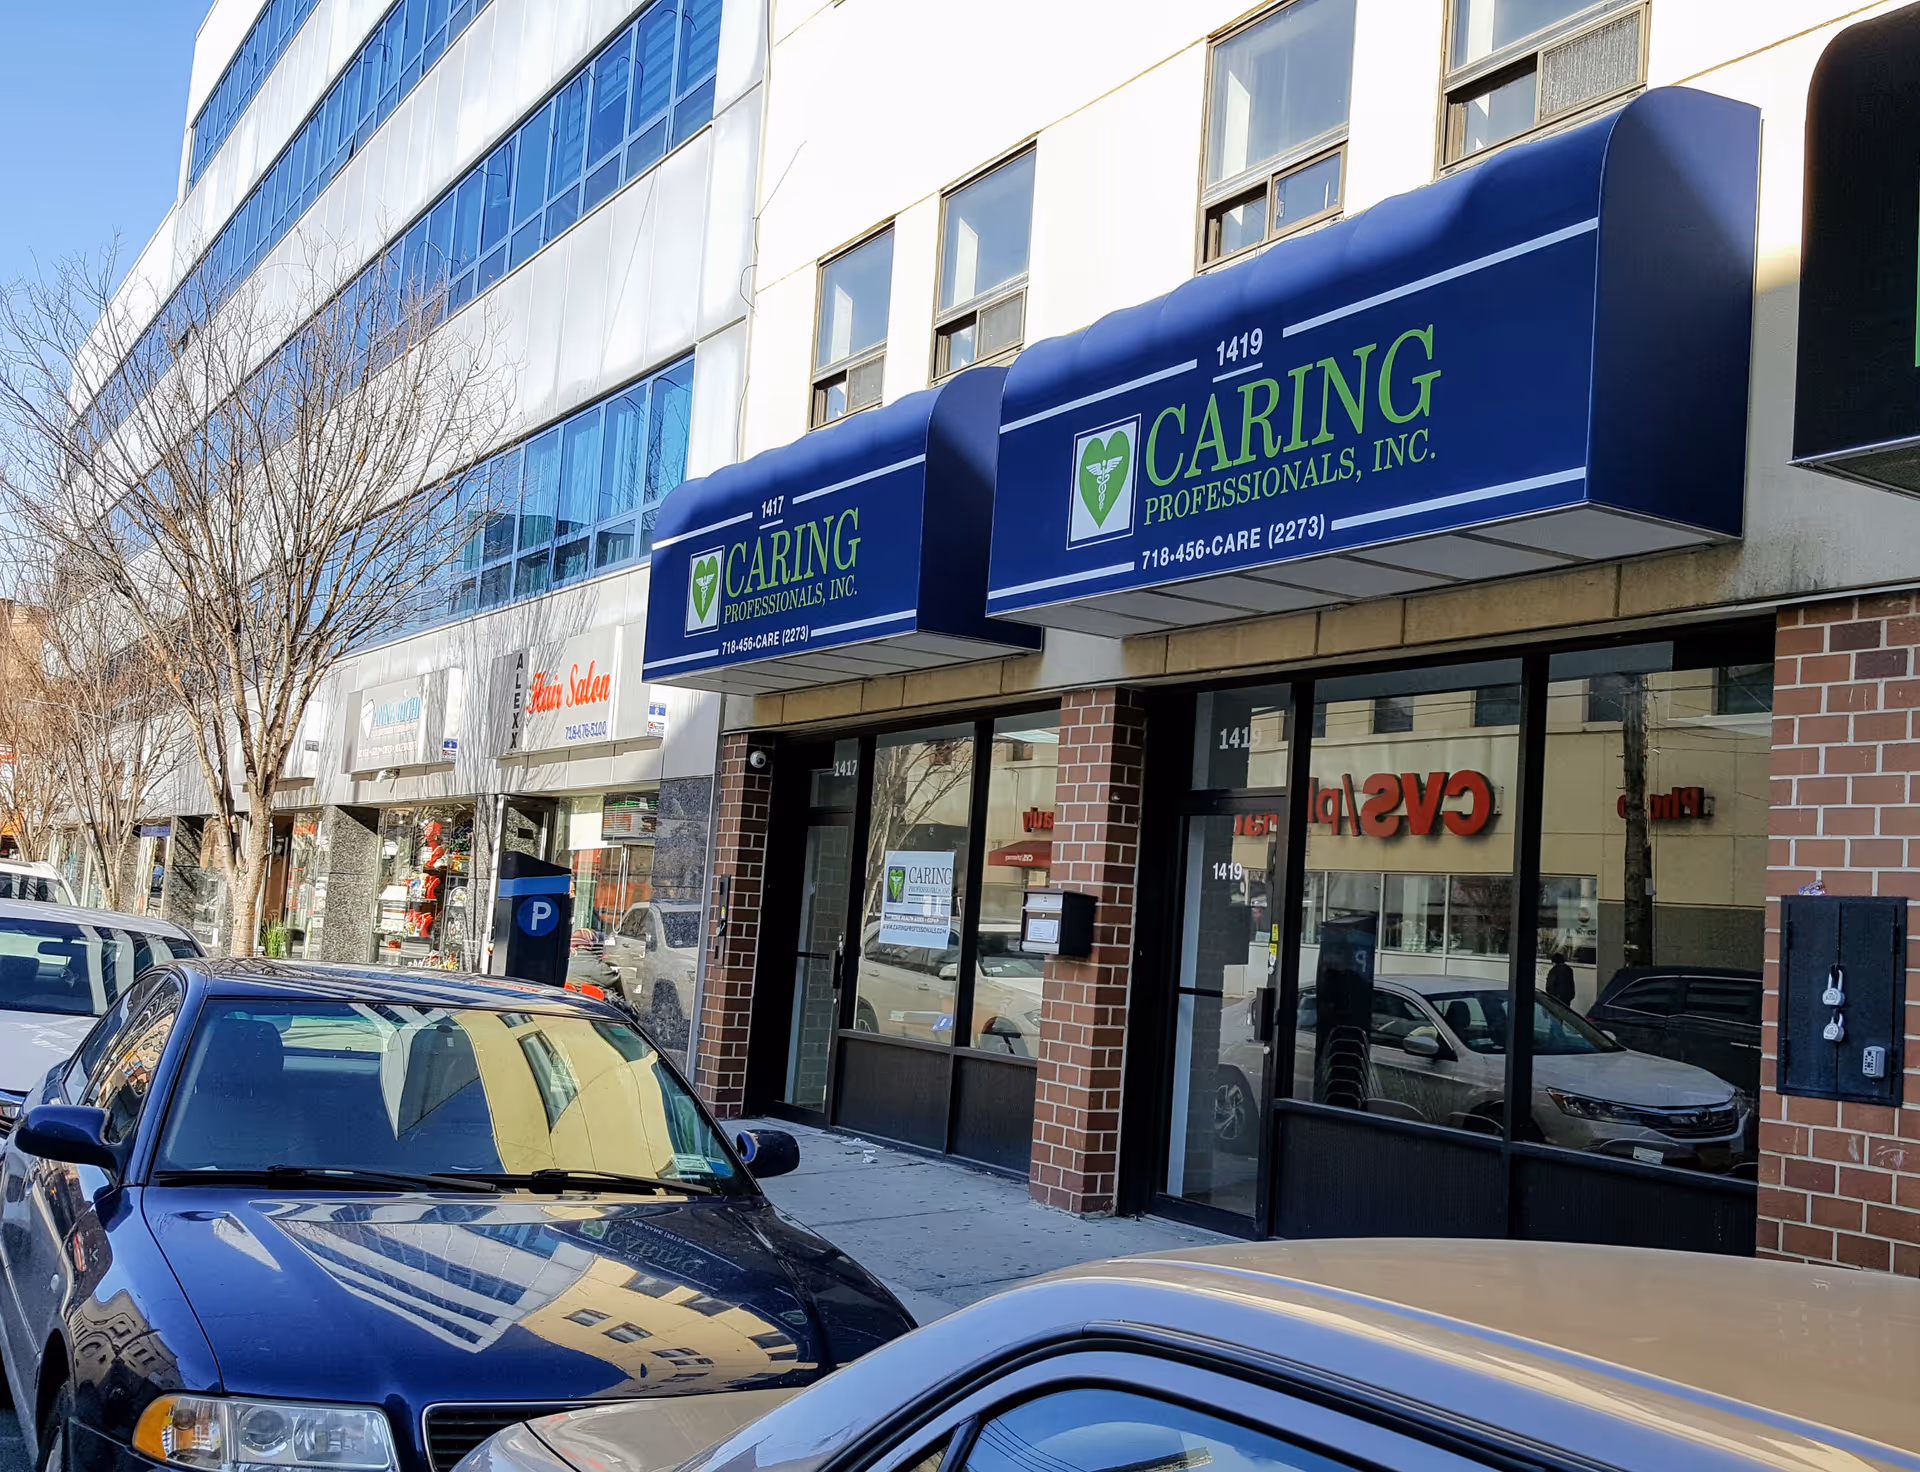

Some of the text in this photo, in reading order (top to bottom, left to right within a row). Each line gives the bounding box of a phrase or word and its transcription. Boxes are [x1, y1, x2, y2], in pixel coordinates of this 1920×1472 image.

[1216, 327, 1263, 366] 1419
[1145, 323, 1442, 486] CARING
[1143, 429, 1437, 526] PROFESSIONALS, INC.
[761, 495, 784, 519] 1417
[1268, 513, 1326, 550] (2273)
[725, 507, 861, 598] CARING
[723, 574, 858, 624] PROFESSIONALS, INC.
[782, 625, 809, 647] (2273)
[526, 659, 610, 714] Hair Salon
[834, 759, 857, 776] 1417
[908, 866, 952, 885] CARING
[1212, 861, 1243, 880] 1419
[531, 901, 552, 931] P
